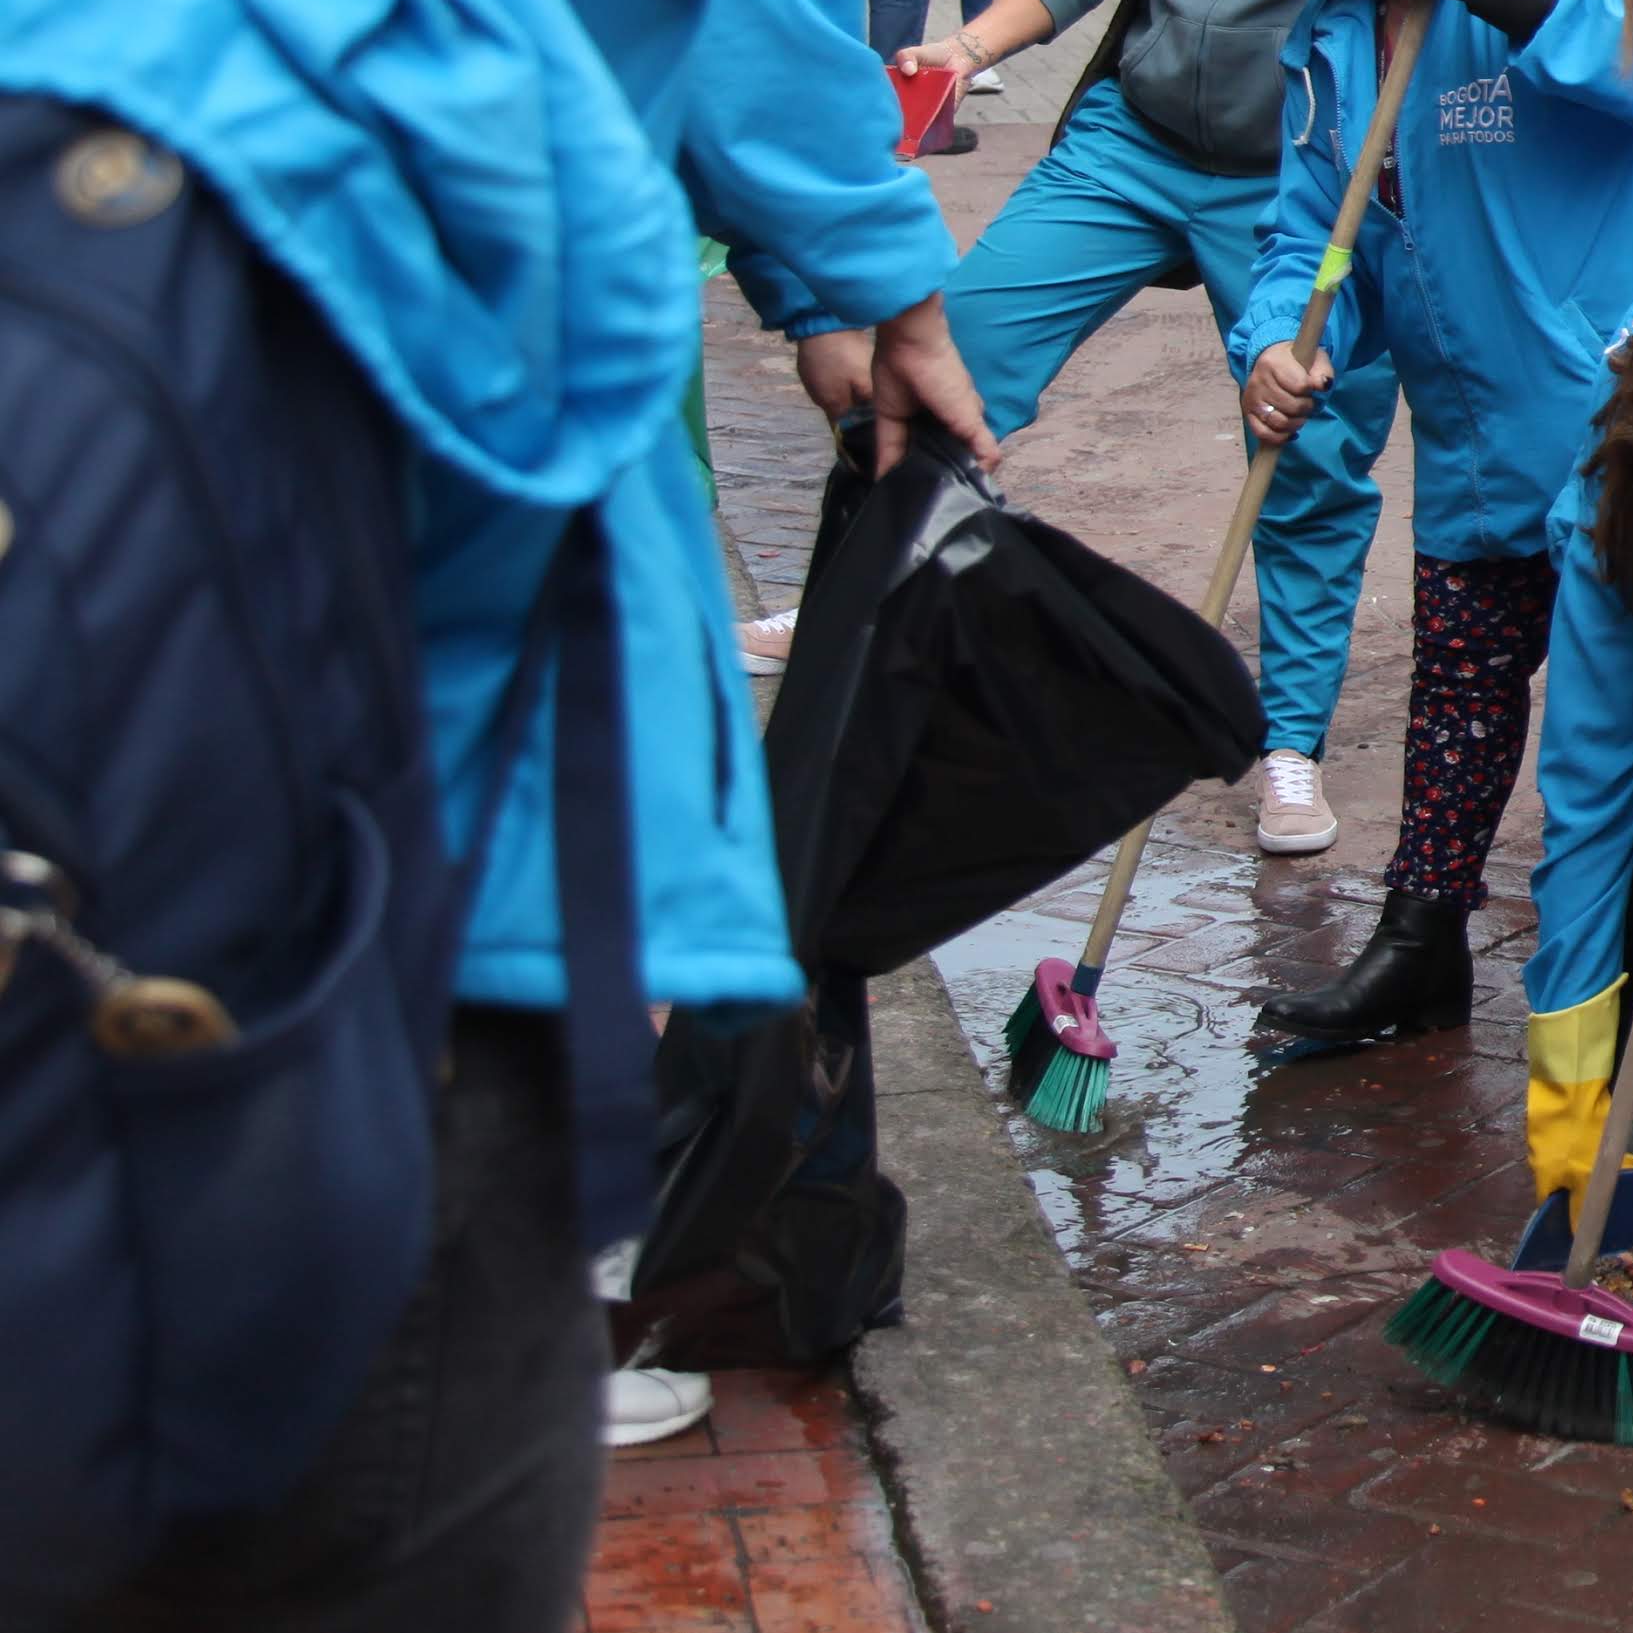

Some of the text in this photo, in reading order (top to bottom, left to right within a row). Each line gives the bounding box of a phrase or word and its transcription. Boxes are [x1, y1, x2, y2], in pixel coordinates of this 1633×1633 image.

[1439, 66, 1513, 106] BOGOTÁ
[1439, 105, 1514, 131] MEJOR
[1439, 130, 1515, 146] PARA TODOS
